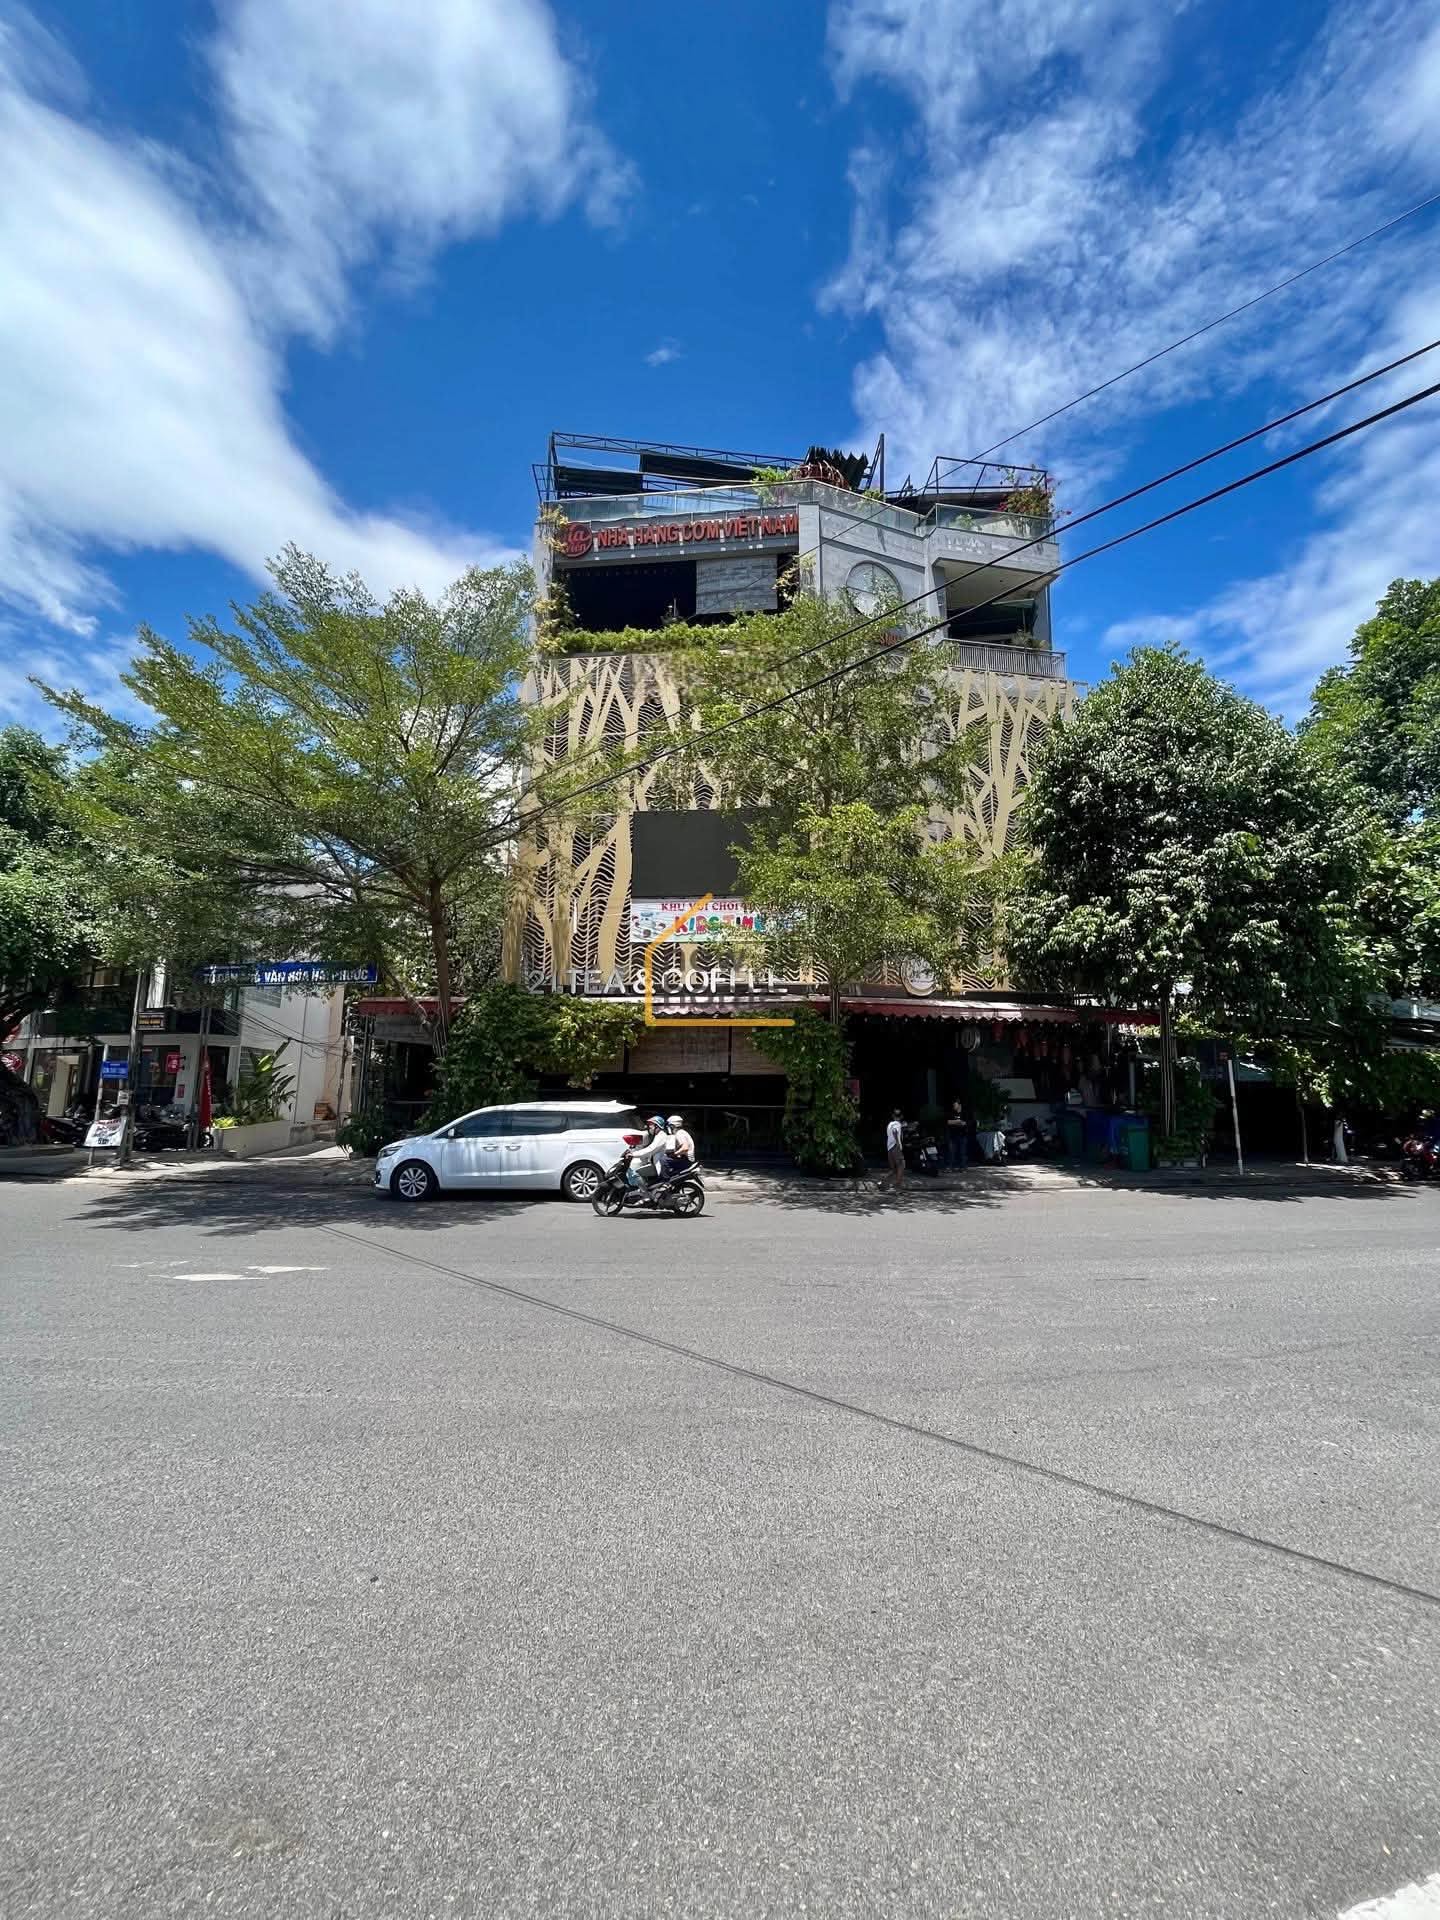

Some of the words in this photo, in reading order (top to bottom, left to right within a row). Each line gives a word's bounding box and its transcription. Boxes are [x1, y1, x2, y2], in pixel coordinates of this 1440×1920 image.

[760, 513, 799, 536] NAM
[563, 967, 626, 995] TEA
[633, 968, 656, 995] &
